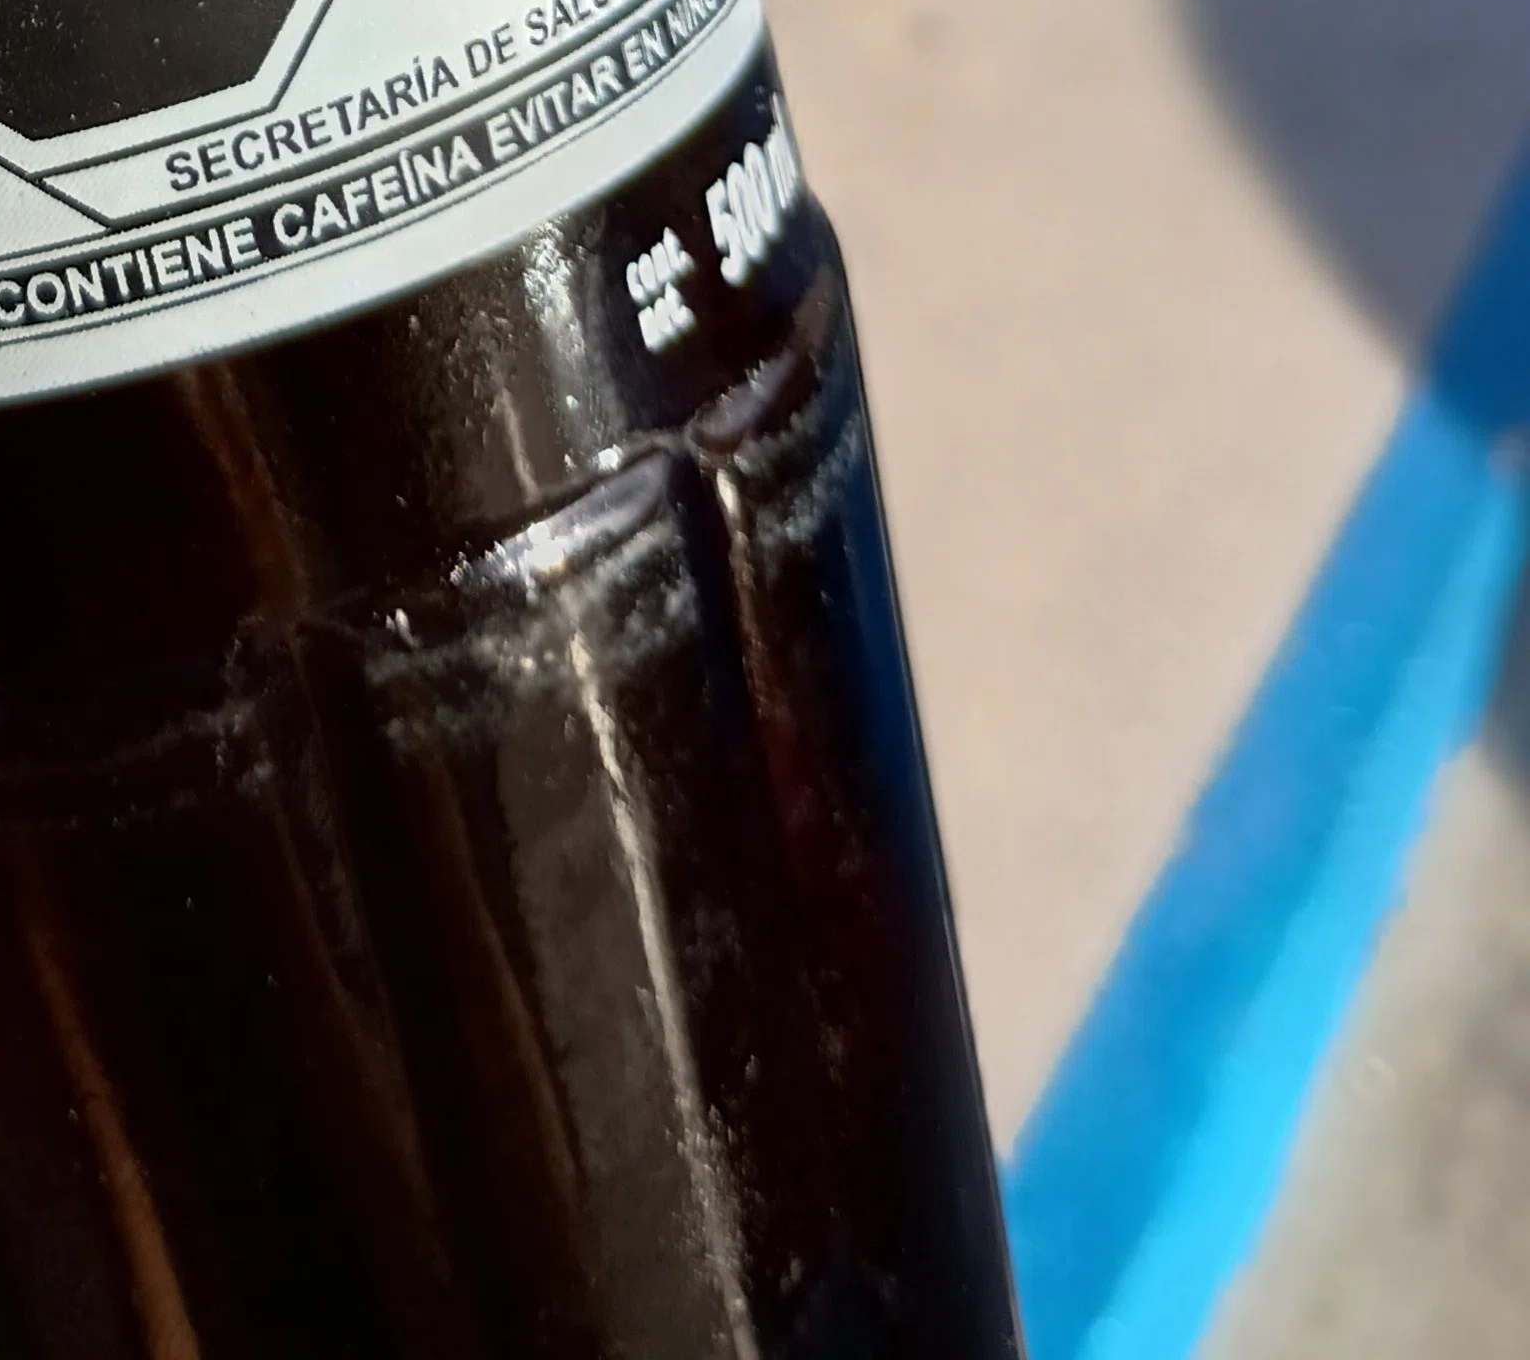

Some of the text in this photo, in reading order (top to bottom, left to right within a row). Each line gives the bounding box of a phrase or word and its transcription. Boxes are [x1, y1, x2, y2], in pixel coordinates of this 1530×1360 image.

[165, 56, 459, 191] SECRETARÍA
[464, 23, 517, 78] DE
[272, 134, 482, 247] CAFEÍNA
[486, 55, 625, 162] EVITAR
[621, 21, 669, 81] EN
[705, 141, 782, 288] 500
